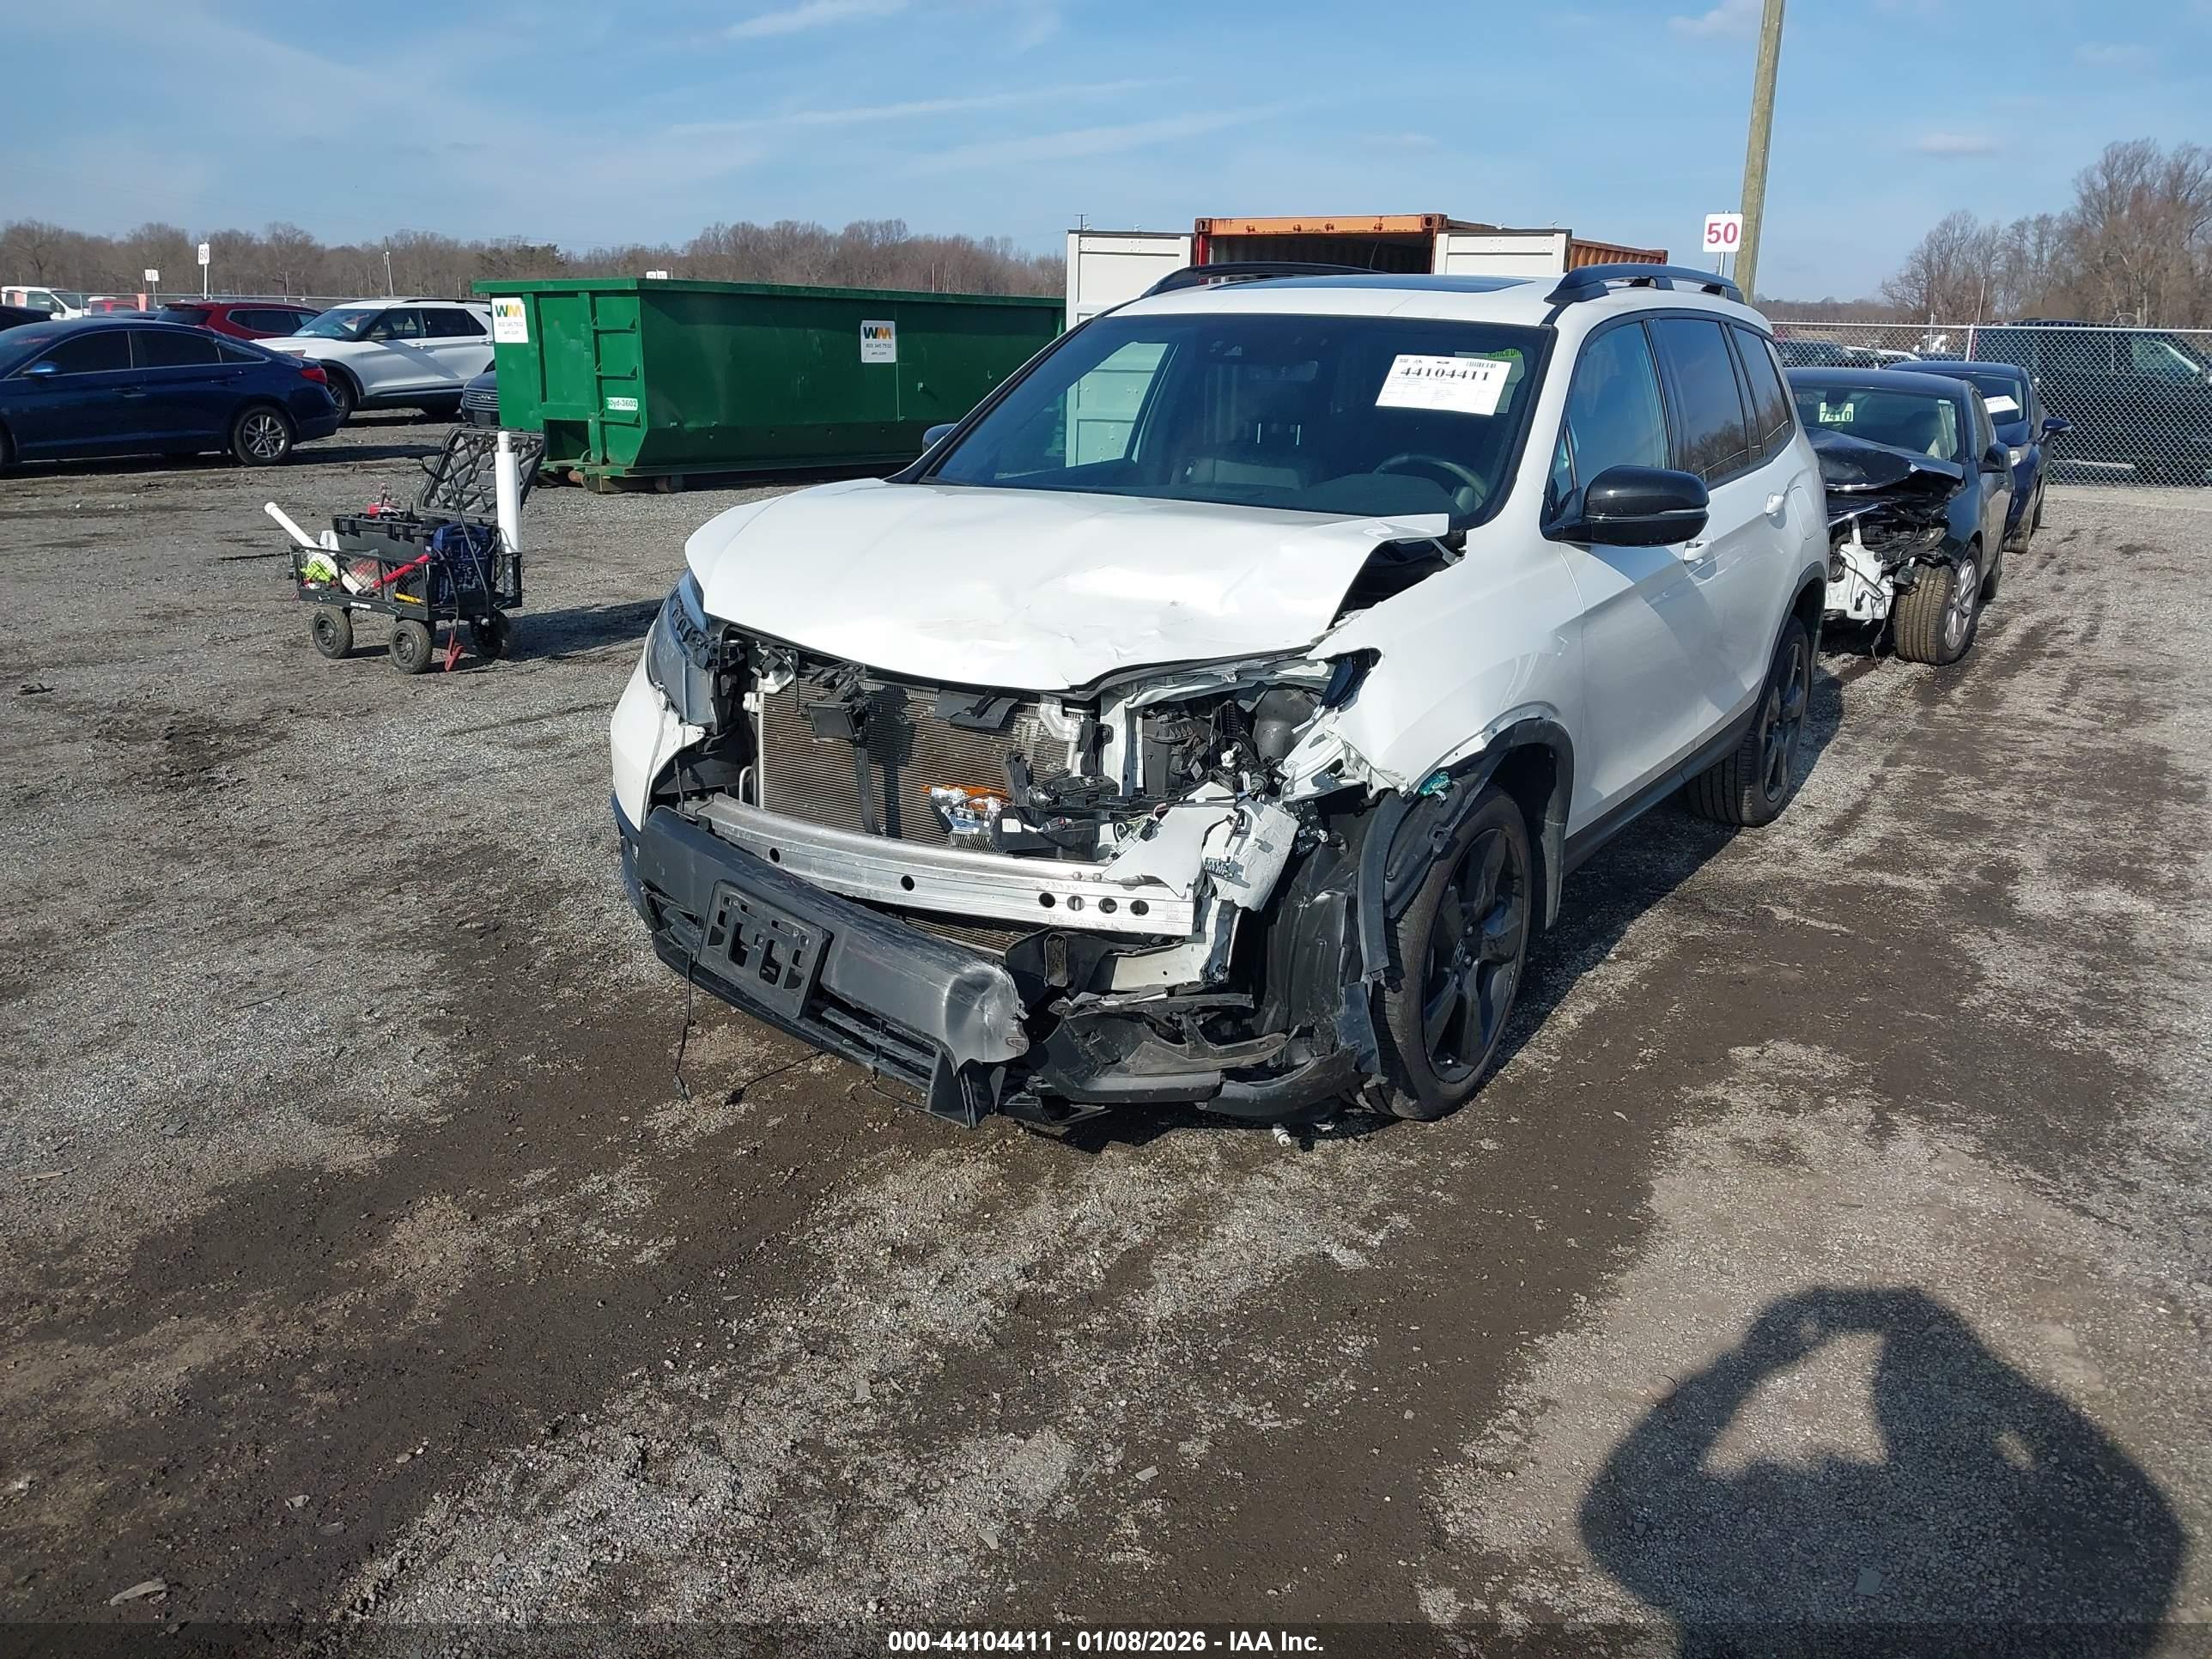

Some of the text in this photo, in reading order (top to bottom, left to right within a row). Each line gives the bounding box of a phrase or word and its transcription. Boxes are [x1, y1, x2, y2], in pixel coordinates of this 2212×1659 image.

[1706, 222, 1739, 245] 50
[199, 248, 209, 260] 60
[495, 304, 523, 318] WM
[862, 326, 893, 340] WM
[1401, 367, 1489, 381] 44104411
[1820, 410, 1852, 422] 7410
